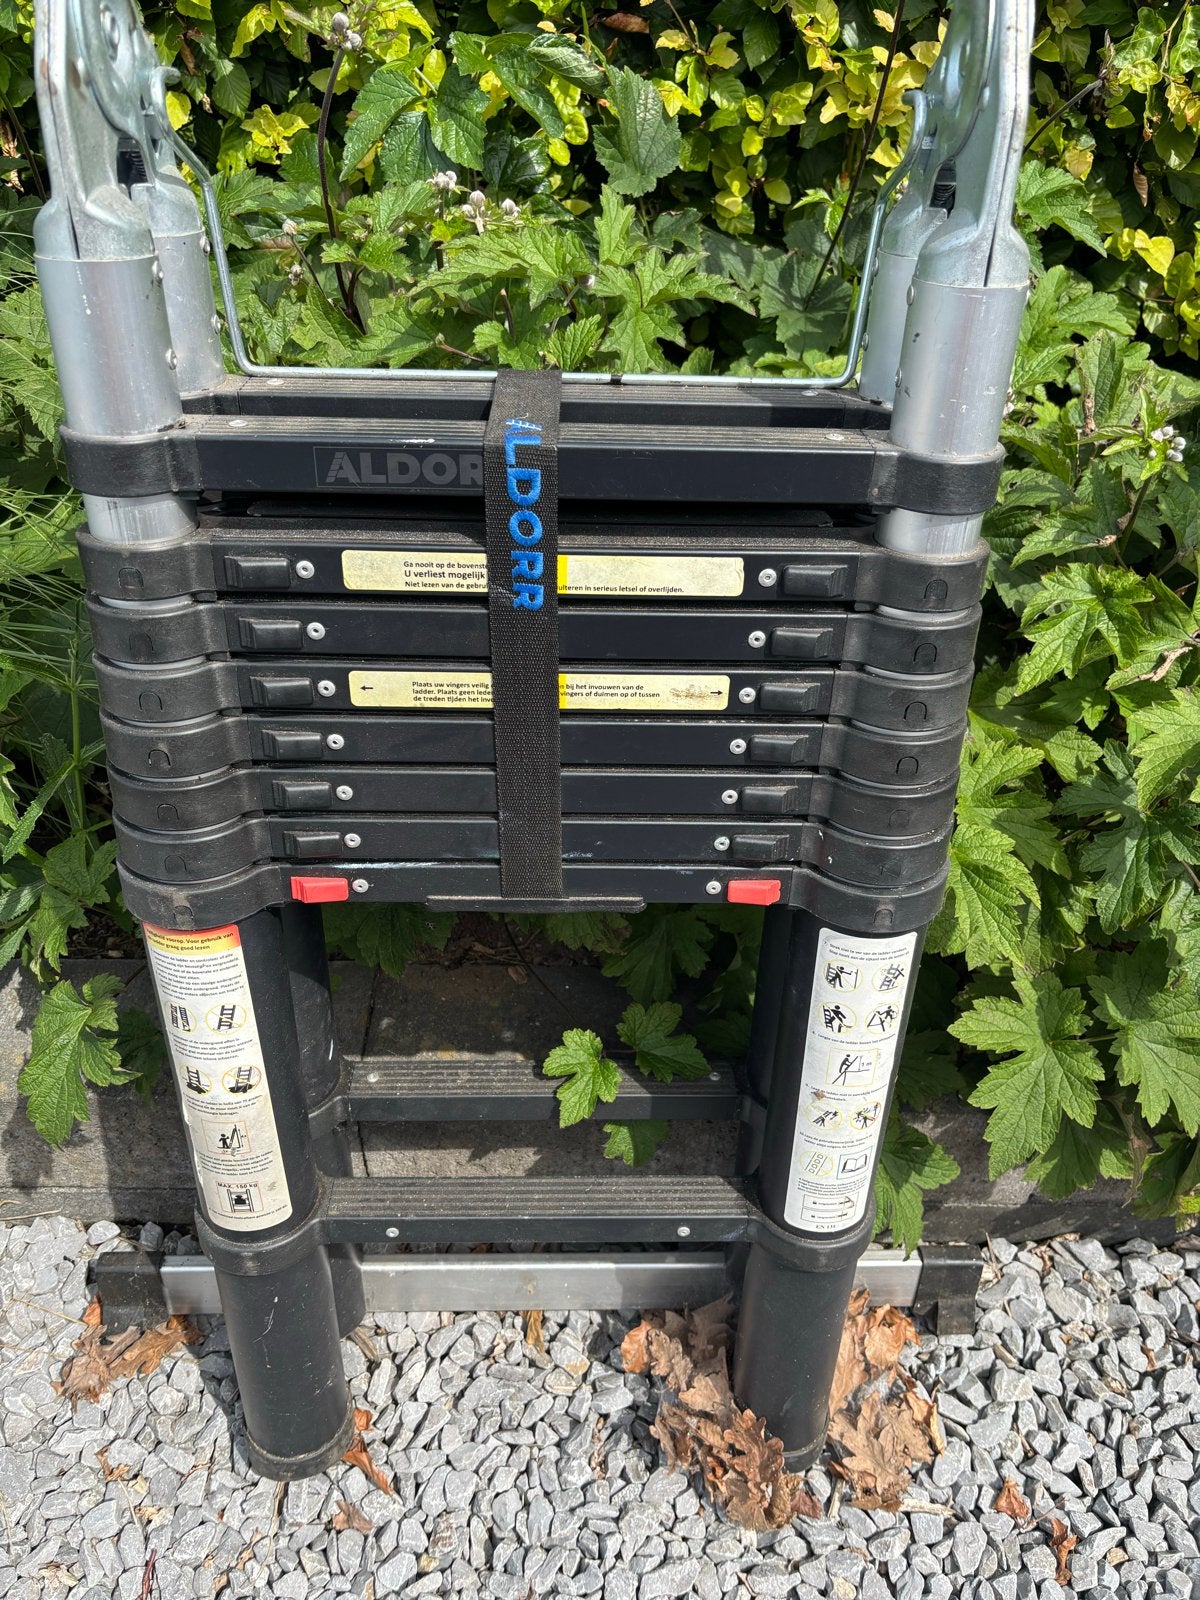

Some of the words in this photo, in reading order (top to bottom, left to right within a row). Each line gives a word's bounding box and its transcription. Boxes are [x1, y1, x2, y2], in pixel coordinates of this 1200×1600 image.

[324, 451, 483, 486] ALDOR
[504, 418, 545, 612] ALDORR
[404, 570, 411, 578] U
[413, 570, 445, 579] verliest
[448, 571, 485, 580] mogelijk
[421, 581, 439, 589] lezen
[619, 585, 638, 593] letsel
[639, 585, 647, 593] of
[648, 585, 684, 594] overlijden.
[446, 681, 470, 690] vingers
[471, 682, 489, 690] veilig
[566, 683, 574, 691] bij
[412, 688, 436, 696] ladder.
[560, 690, 584, 698] vingers
